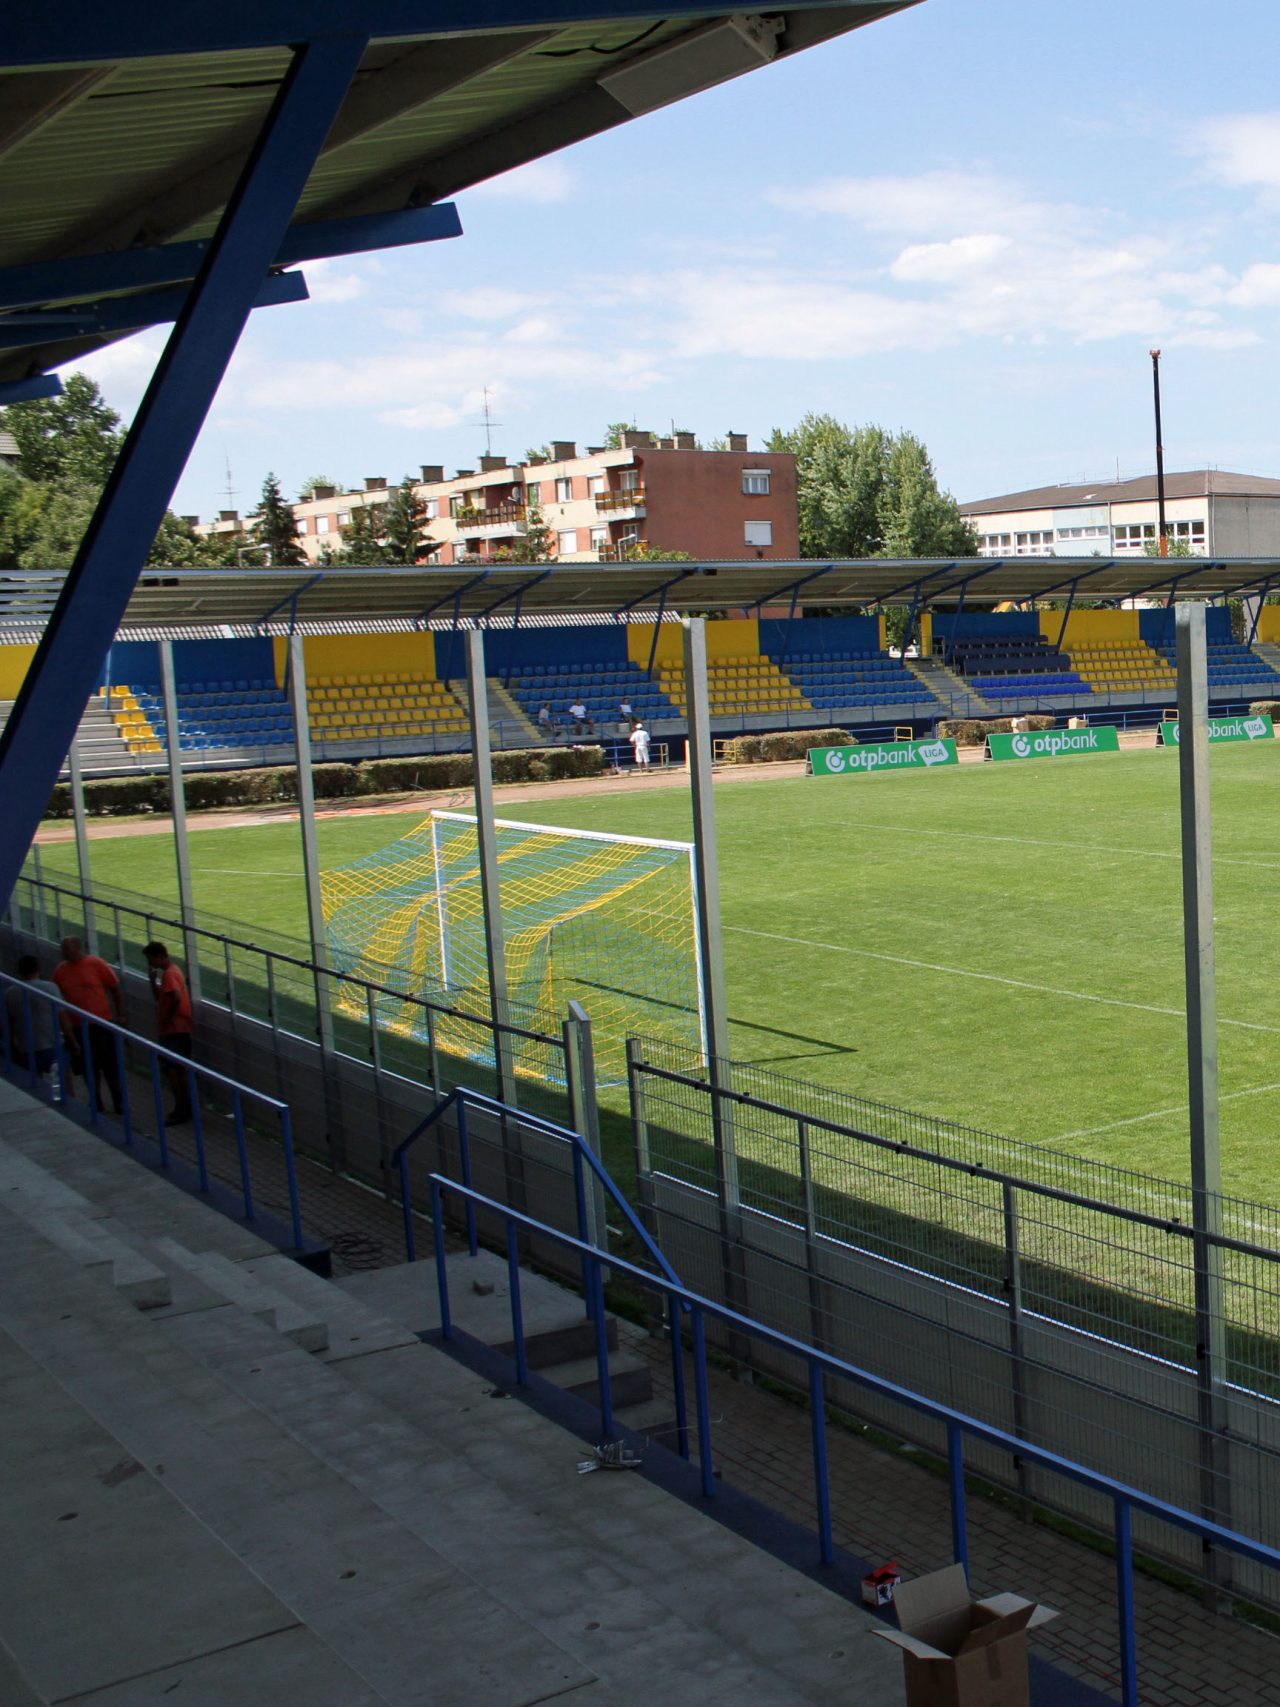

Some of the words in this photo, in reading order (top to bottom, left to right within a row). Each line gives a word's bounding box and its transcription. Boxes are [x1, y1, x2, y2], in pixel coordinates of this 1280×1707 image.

[1034, 729, 1099, 756] otpbank
[849, 744, 918, 771] otpbank
[924, 746, 945, 759] LIGA
